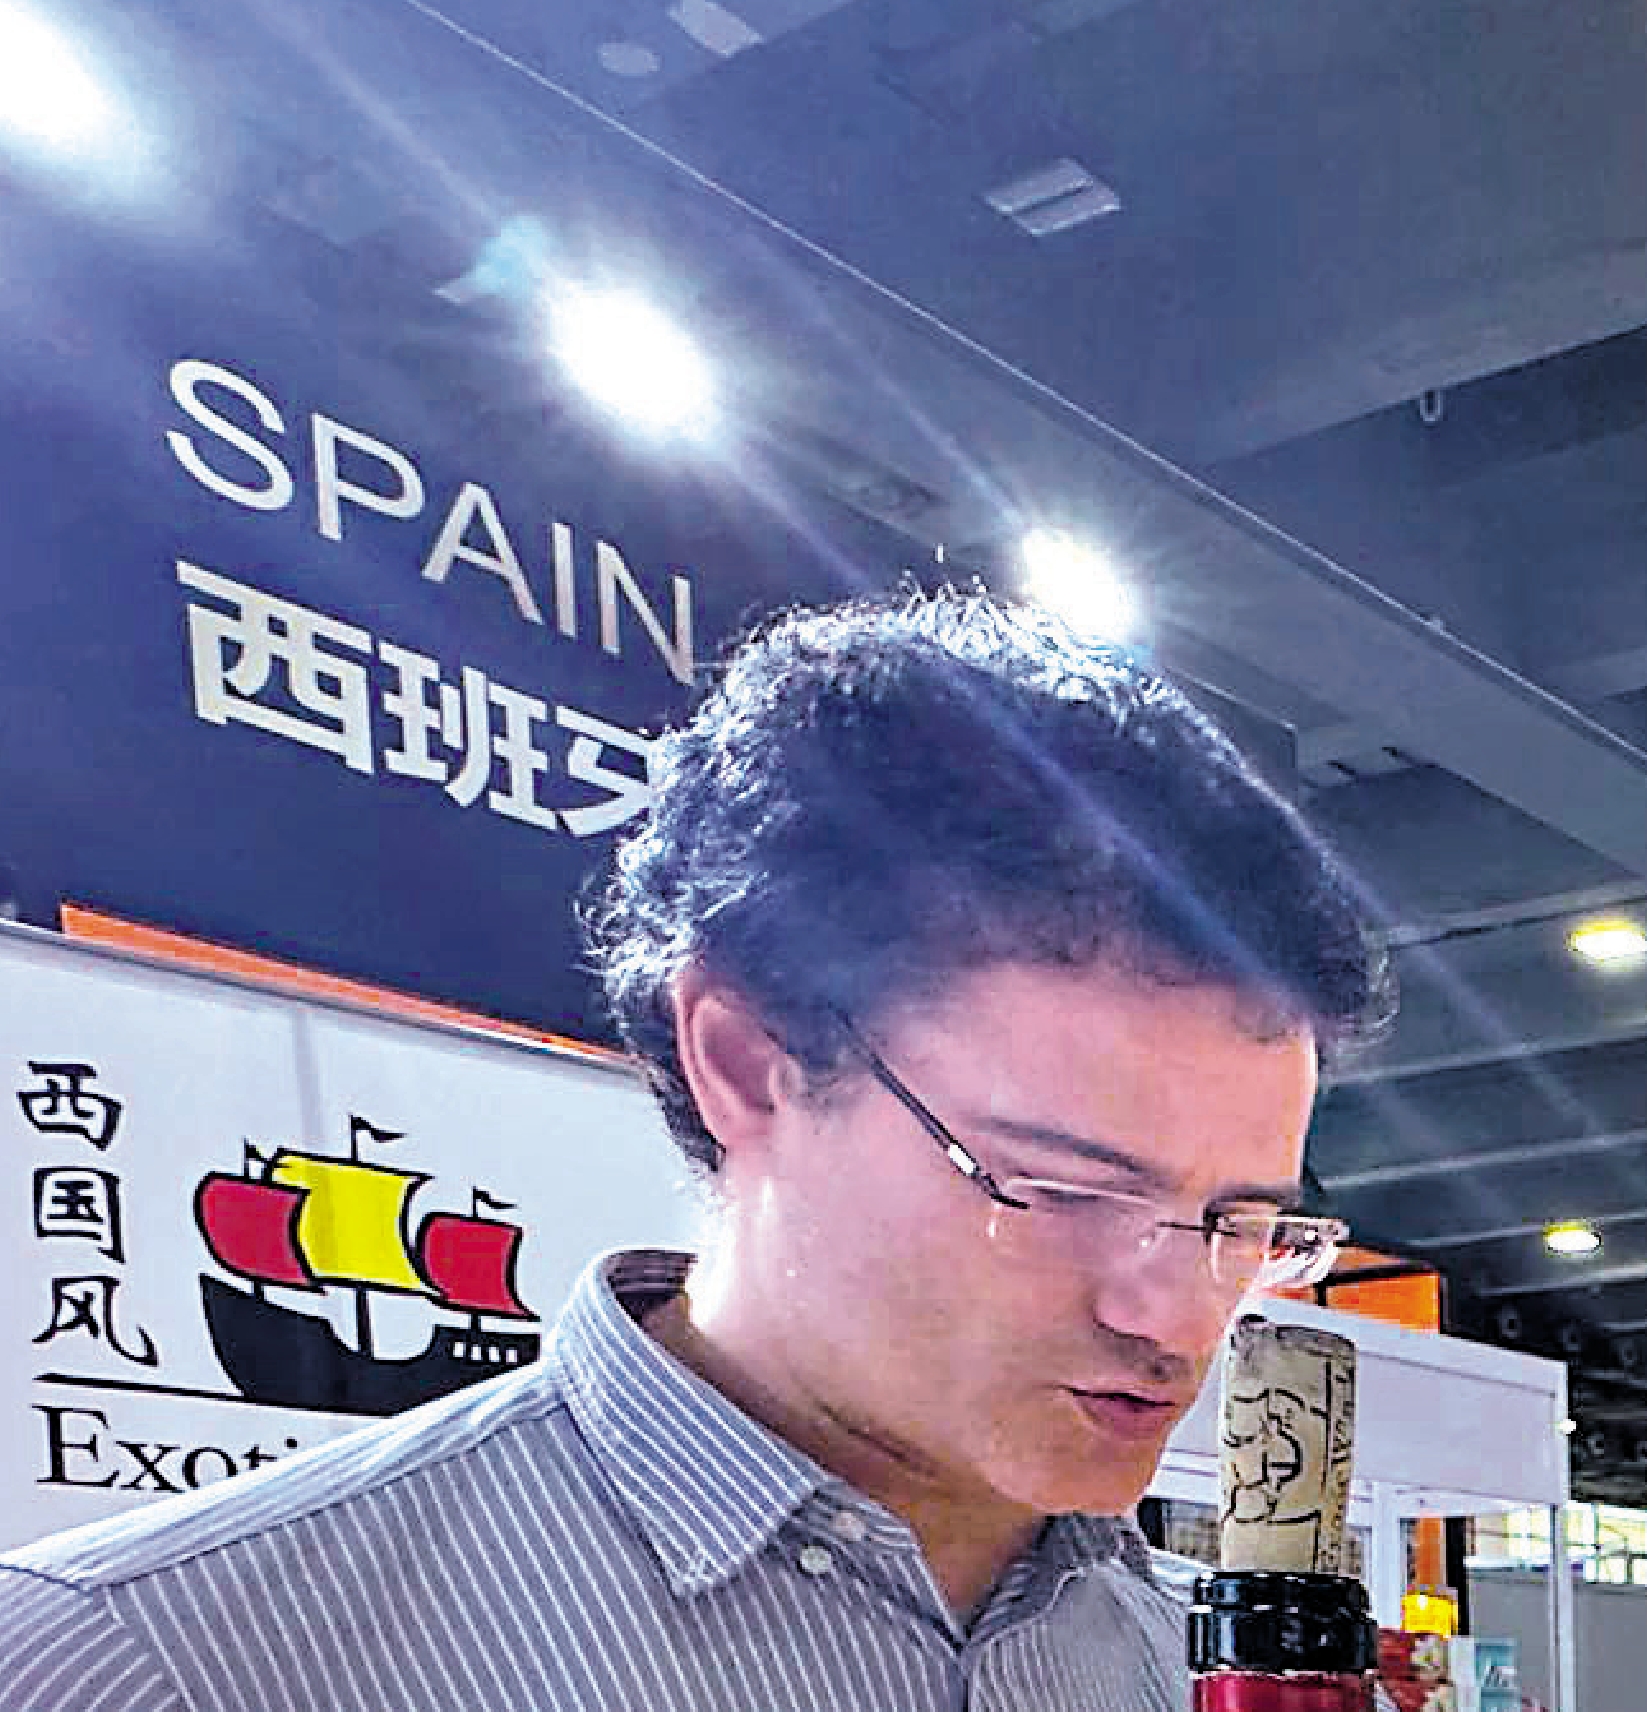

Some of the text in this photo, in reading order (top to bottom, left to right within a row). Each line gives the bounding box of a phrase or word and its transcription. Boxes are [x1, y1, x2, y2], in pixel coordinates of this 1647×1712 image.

[165, 358, 696, 687] SPAIN
[17, 1060, 158, 1367] 西国风
